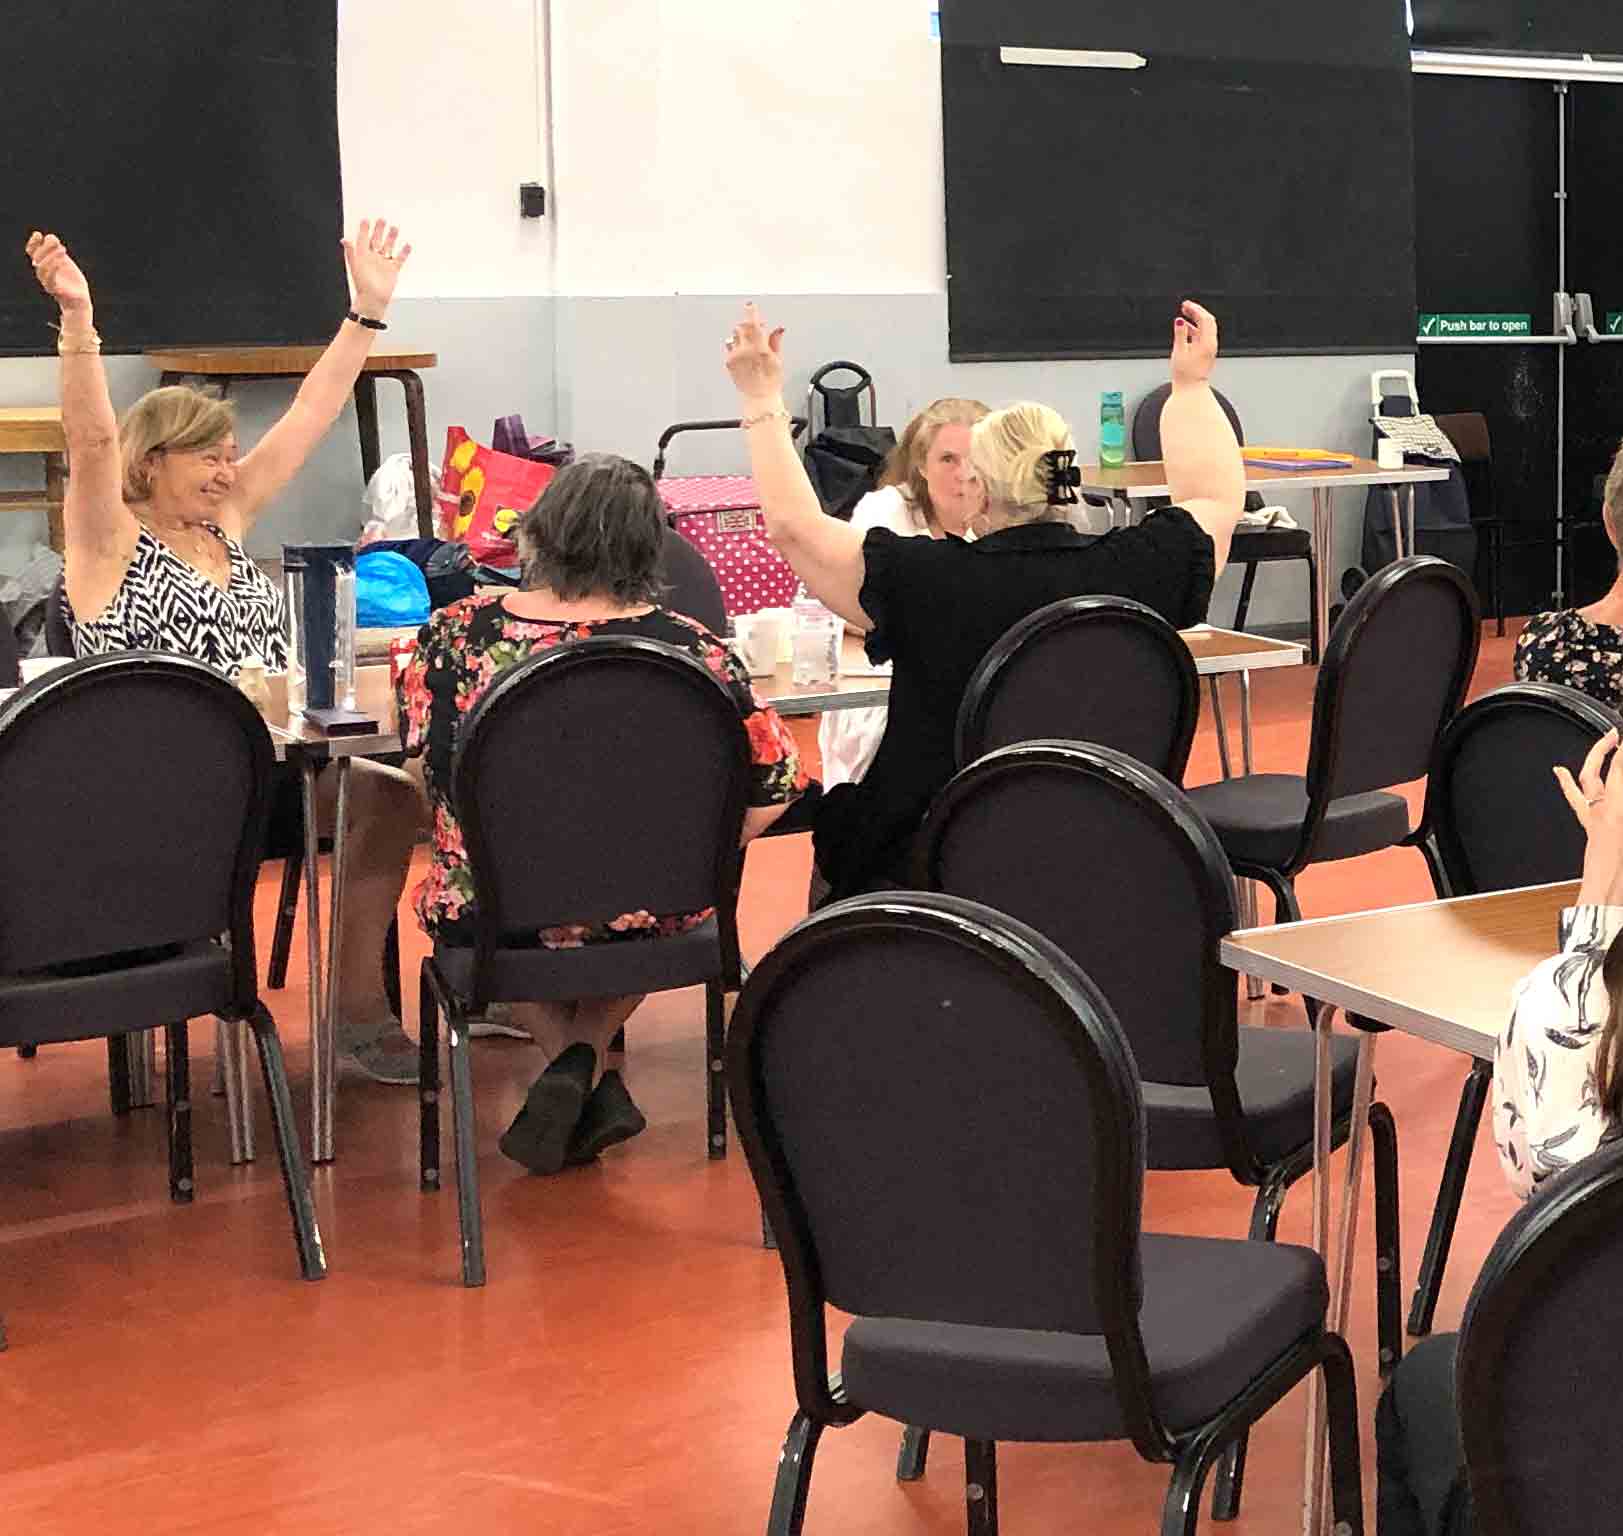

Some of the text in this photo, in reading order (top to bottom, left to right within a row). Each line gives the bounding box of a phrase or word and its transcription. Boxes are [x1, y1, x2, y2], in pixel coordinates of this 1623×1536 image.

[1440, 320, 1528, 333] Push bar to open
